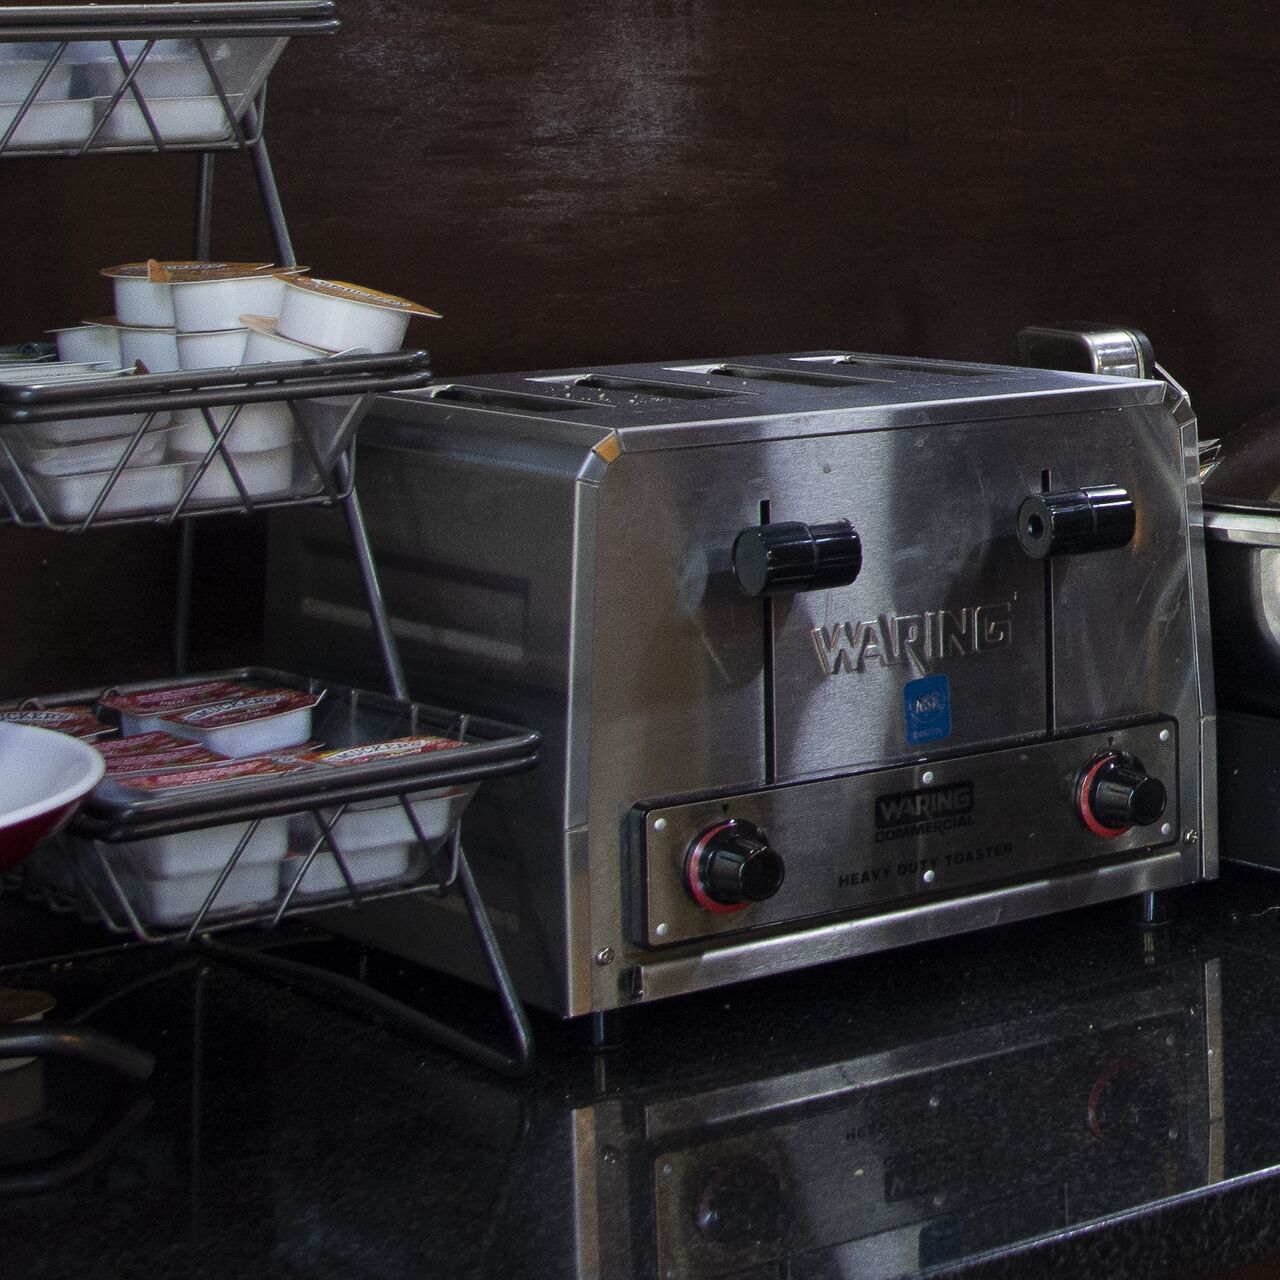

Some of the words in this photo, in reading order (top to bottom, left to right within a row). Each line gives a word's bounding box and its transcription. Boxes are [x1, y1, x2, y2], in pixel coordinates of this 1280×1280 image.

[811, 601, 1012, 678] WARING
[877, 785, 972, 820] WARING
[874, 816, 976, 843] COMMERCIAL
[839, 866, 895, 888] HEAVY
[897, 857, 939, 876] DUTY
[945, 842, 1013, 867] TOASTER
